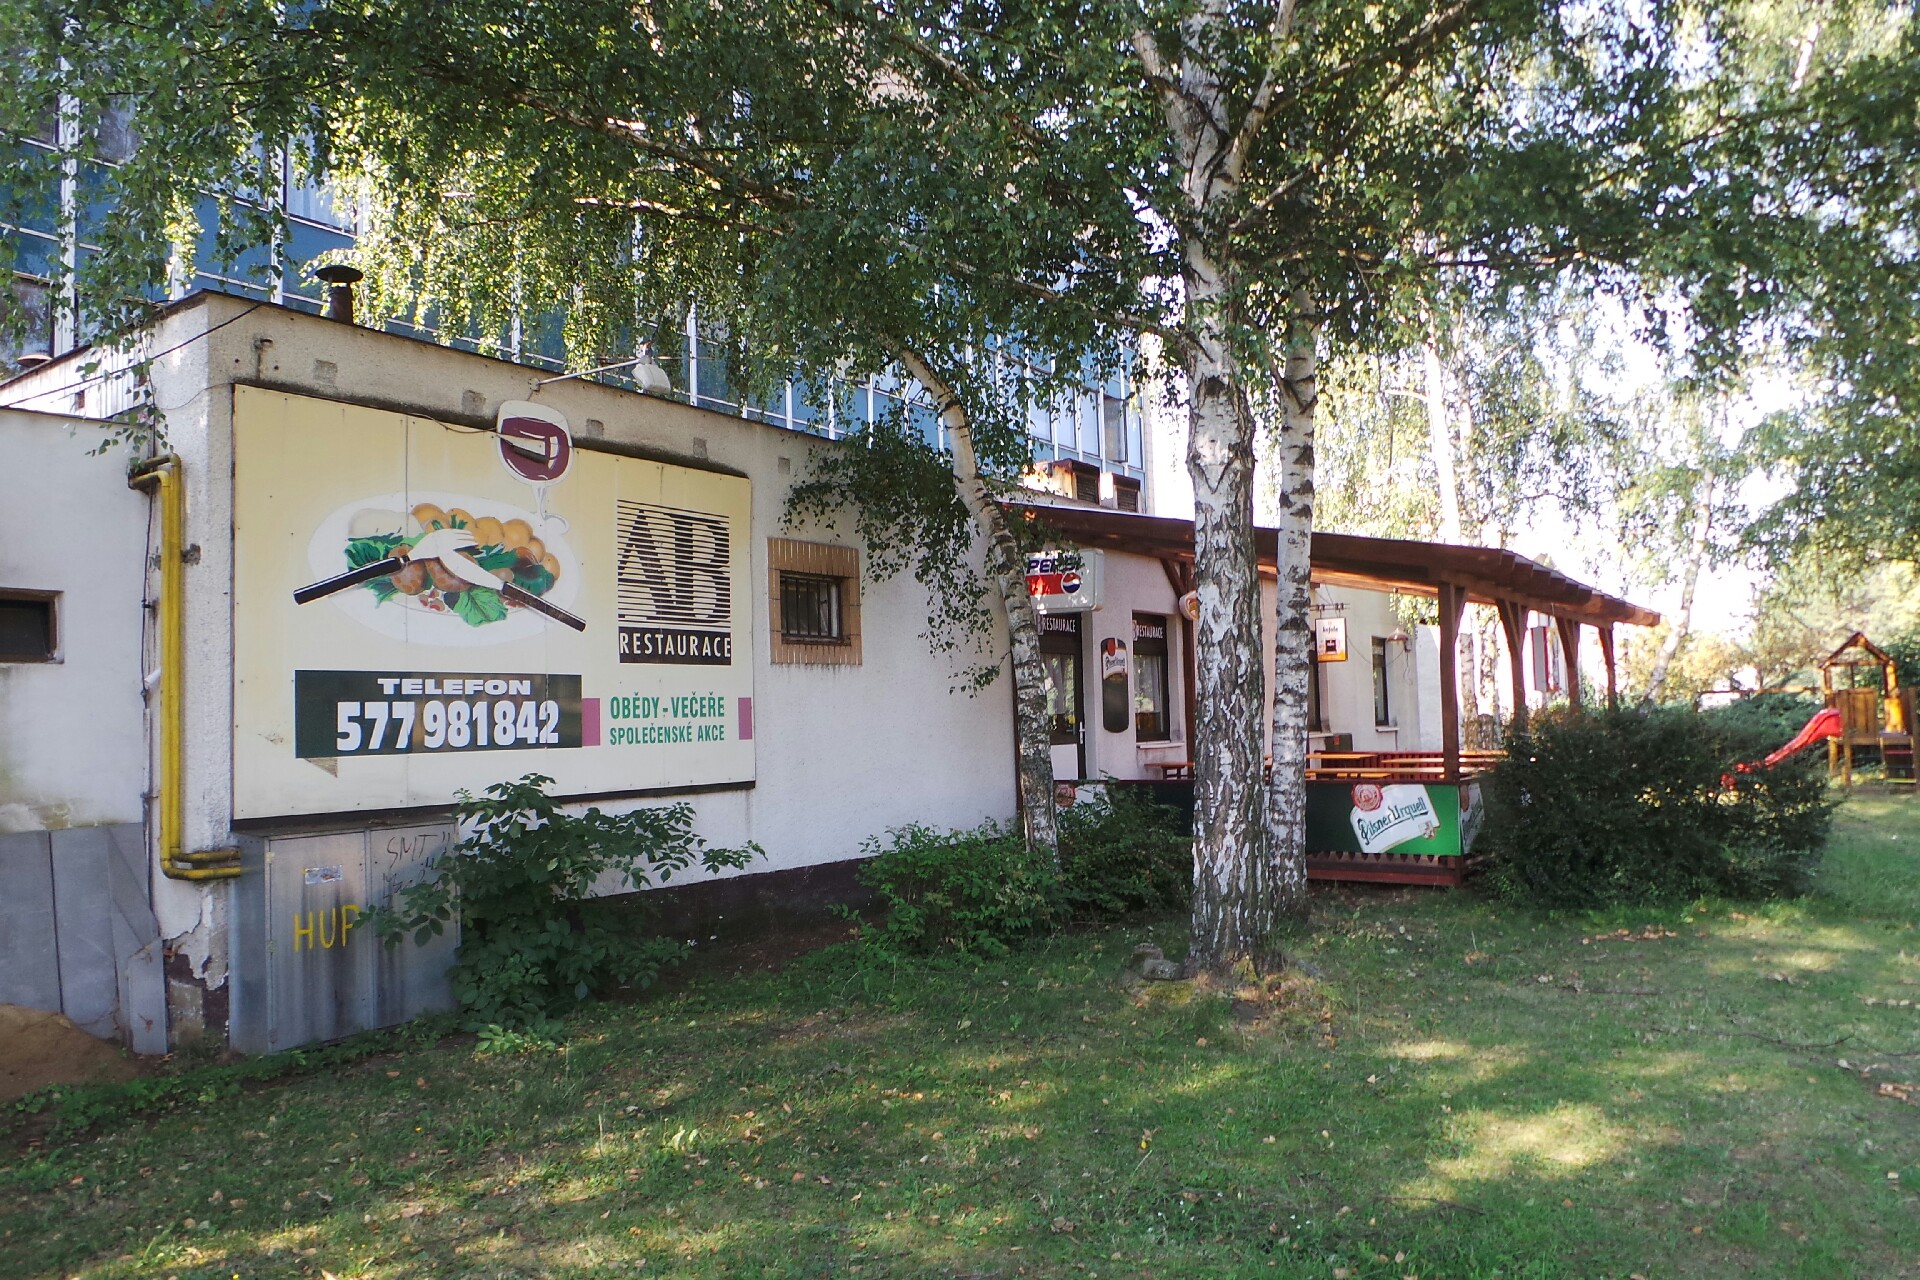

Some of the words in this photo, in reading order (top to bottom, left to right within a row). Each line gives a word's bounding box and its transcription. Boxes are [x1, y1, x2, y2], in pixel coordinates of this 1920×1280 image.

[1043, 617, 1076, 633] RESTAURACE
[1136, 624, 1163, 639] RESTAURACE
[619, 632, 731, 658] RESTAURACE
[377, 678, 531, 695] TELEFON
[336, 700, 415, 751] 577
[609, 722, 692, 746] SPOLEČENSKÉ
[697, 724, 725, 742] AKCE
[1357, 812, 1392, 846] Pilsner
[1388, 797, 1428, 820] Urquell
[293, 903, 361, 953] HUP
